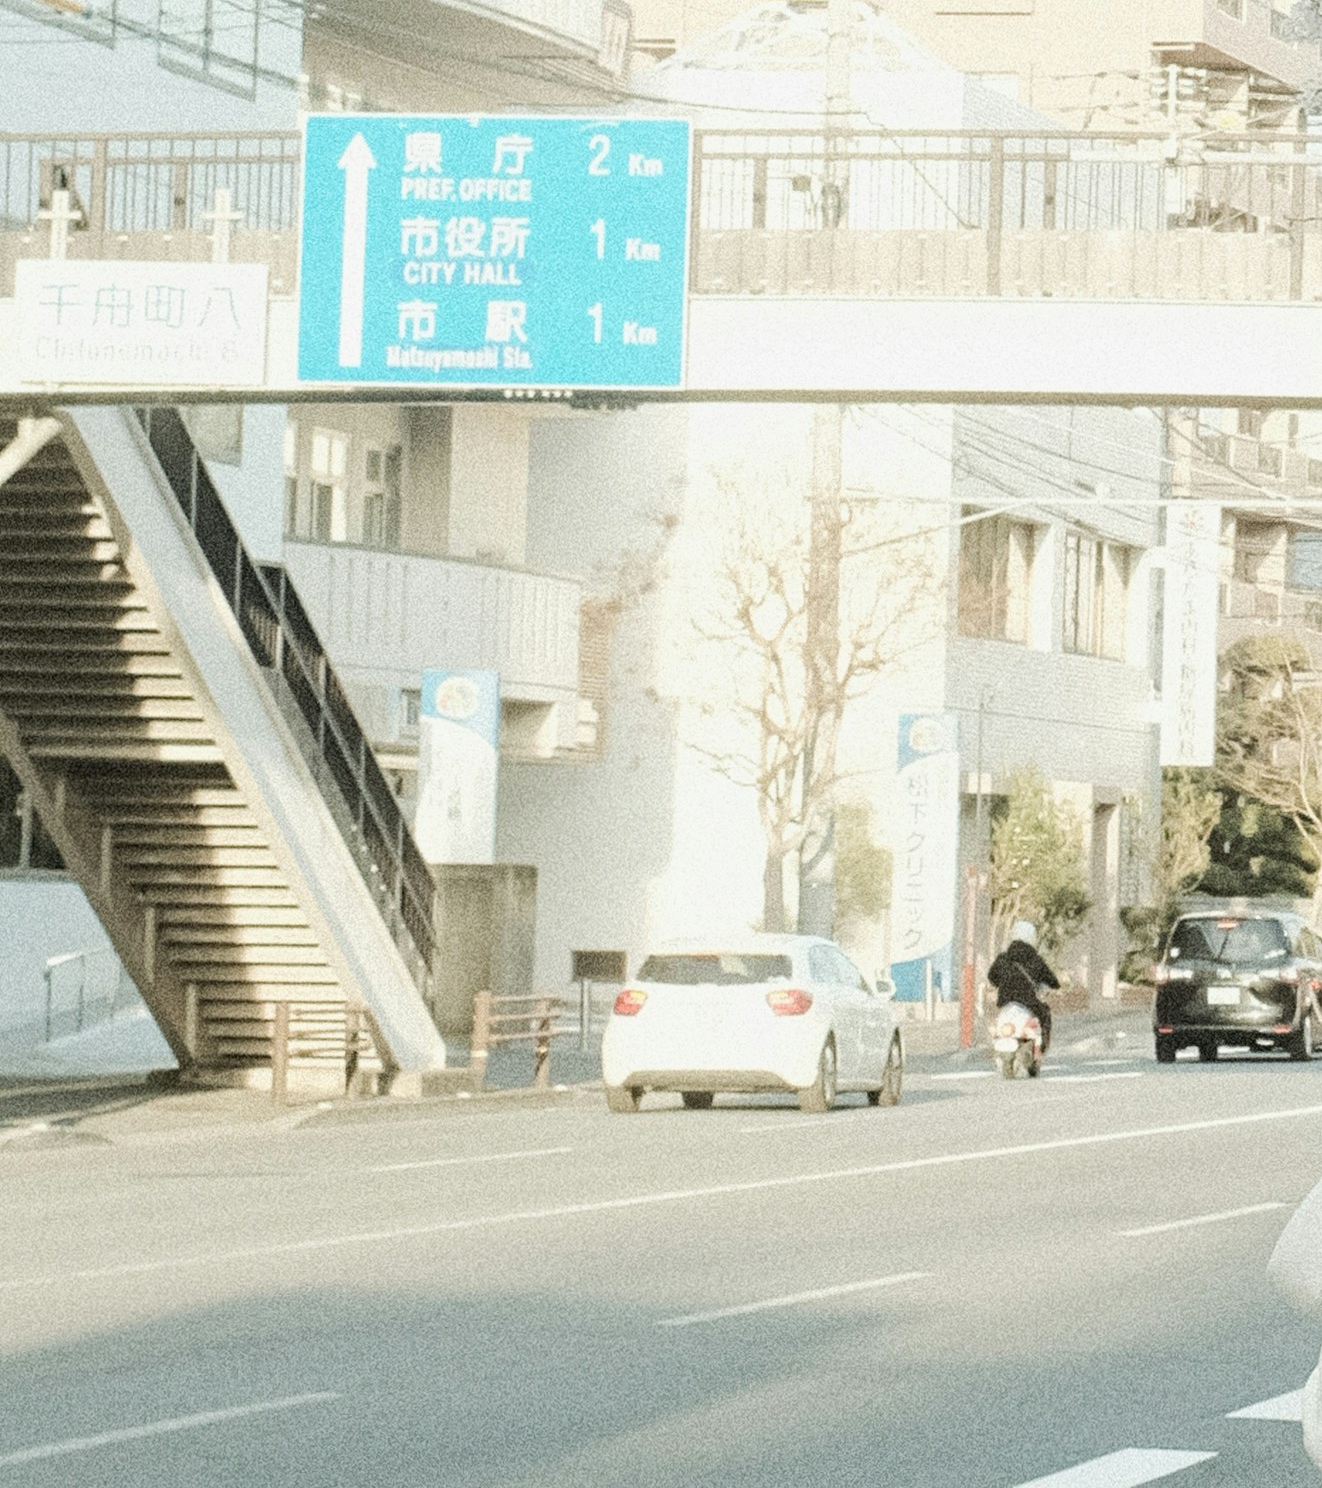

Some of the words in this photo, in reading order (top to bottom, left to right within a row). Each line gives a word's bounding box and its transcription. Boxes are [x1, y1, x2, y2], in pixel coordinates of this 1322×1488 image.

[588, 134, 611, 176] 2
[628, 153, 663, 178] Km
[400, 215, 532, 259] 市役所
[590, 218, 606, 260] 1
[626, 238, 661, 261] Km
[403, 261, 456, 285] CITY
[464, 262, 522, 286] HALL
[587, 302, 603, 344] 1
[623, 322, 658, 345] Km
